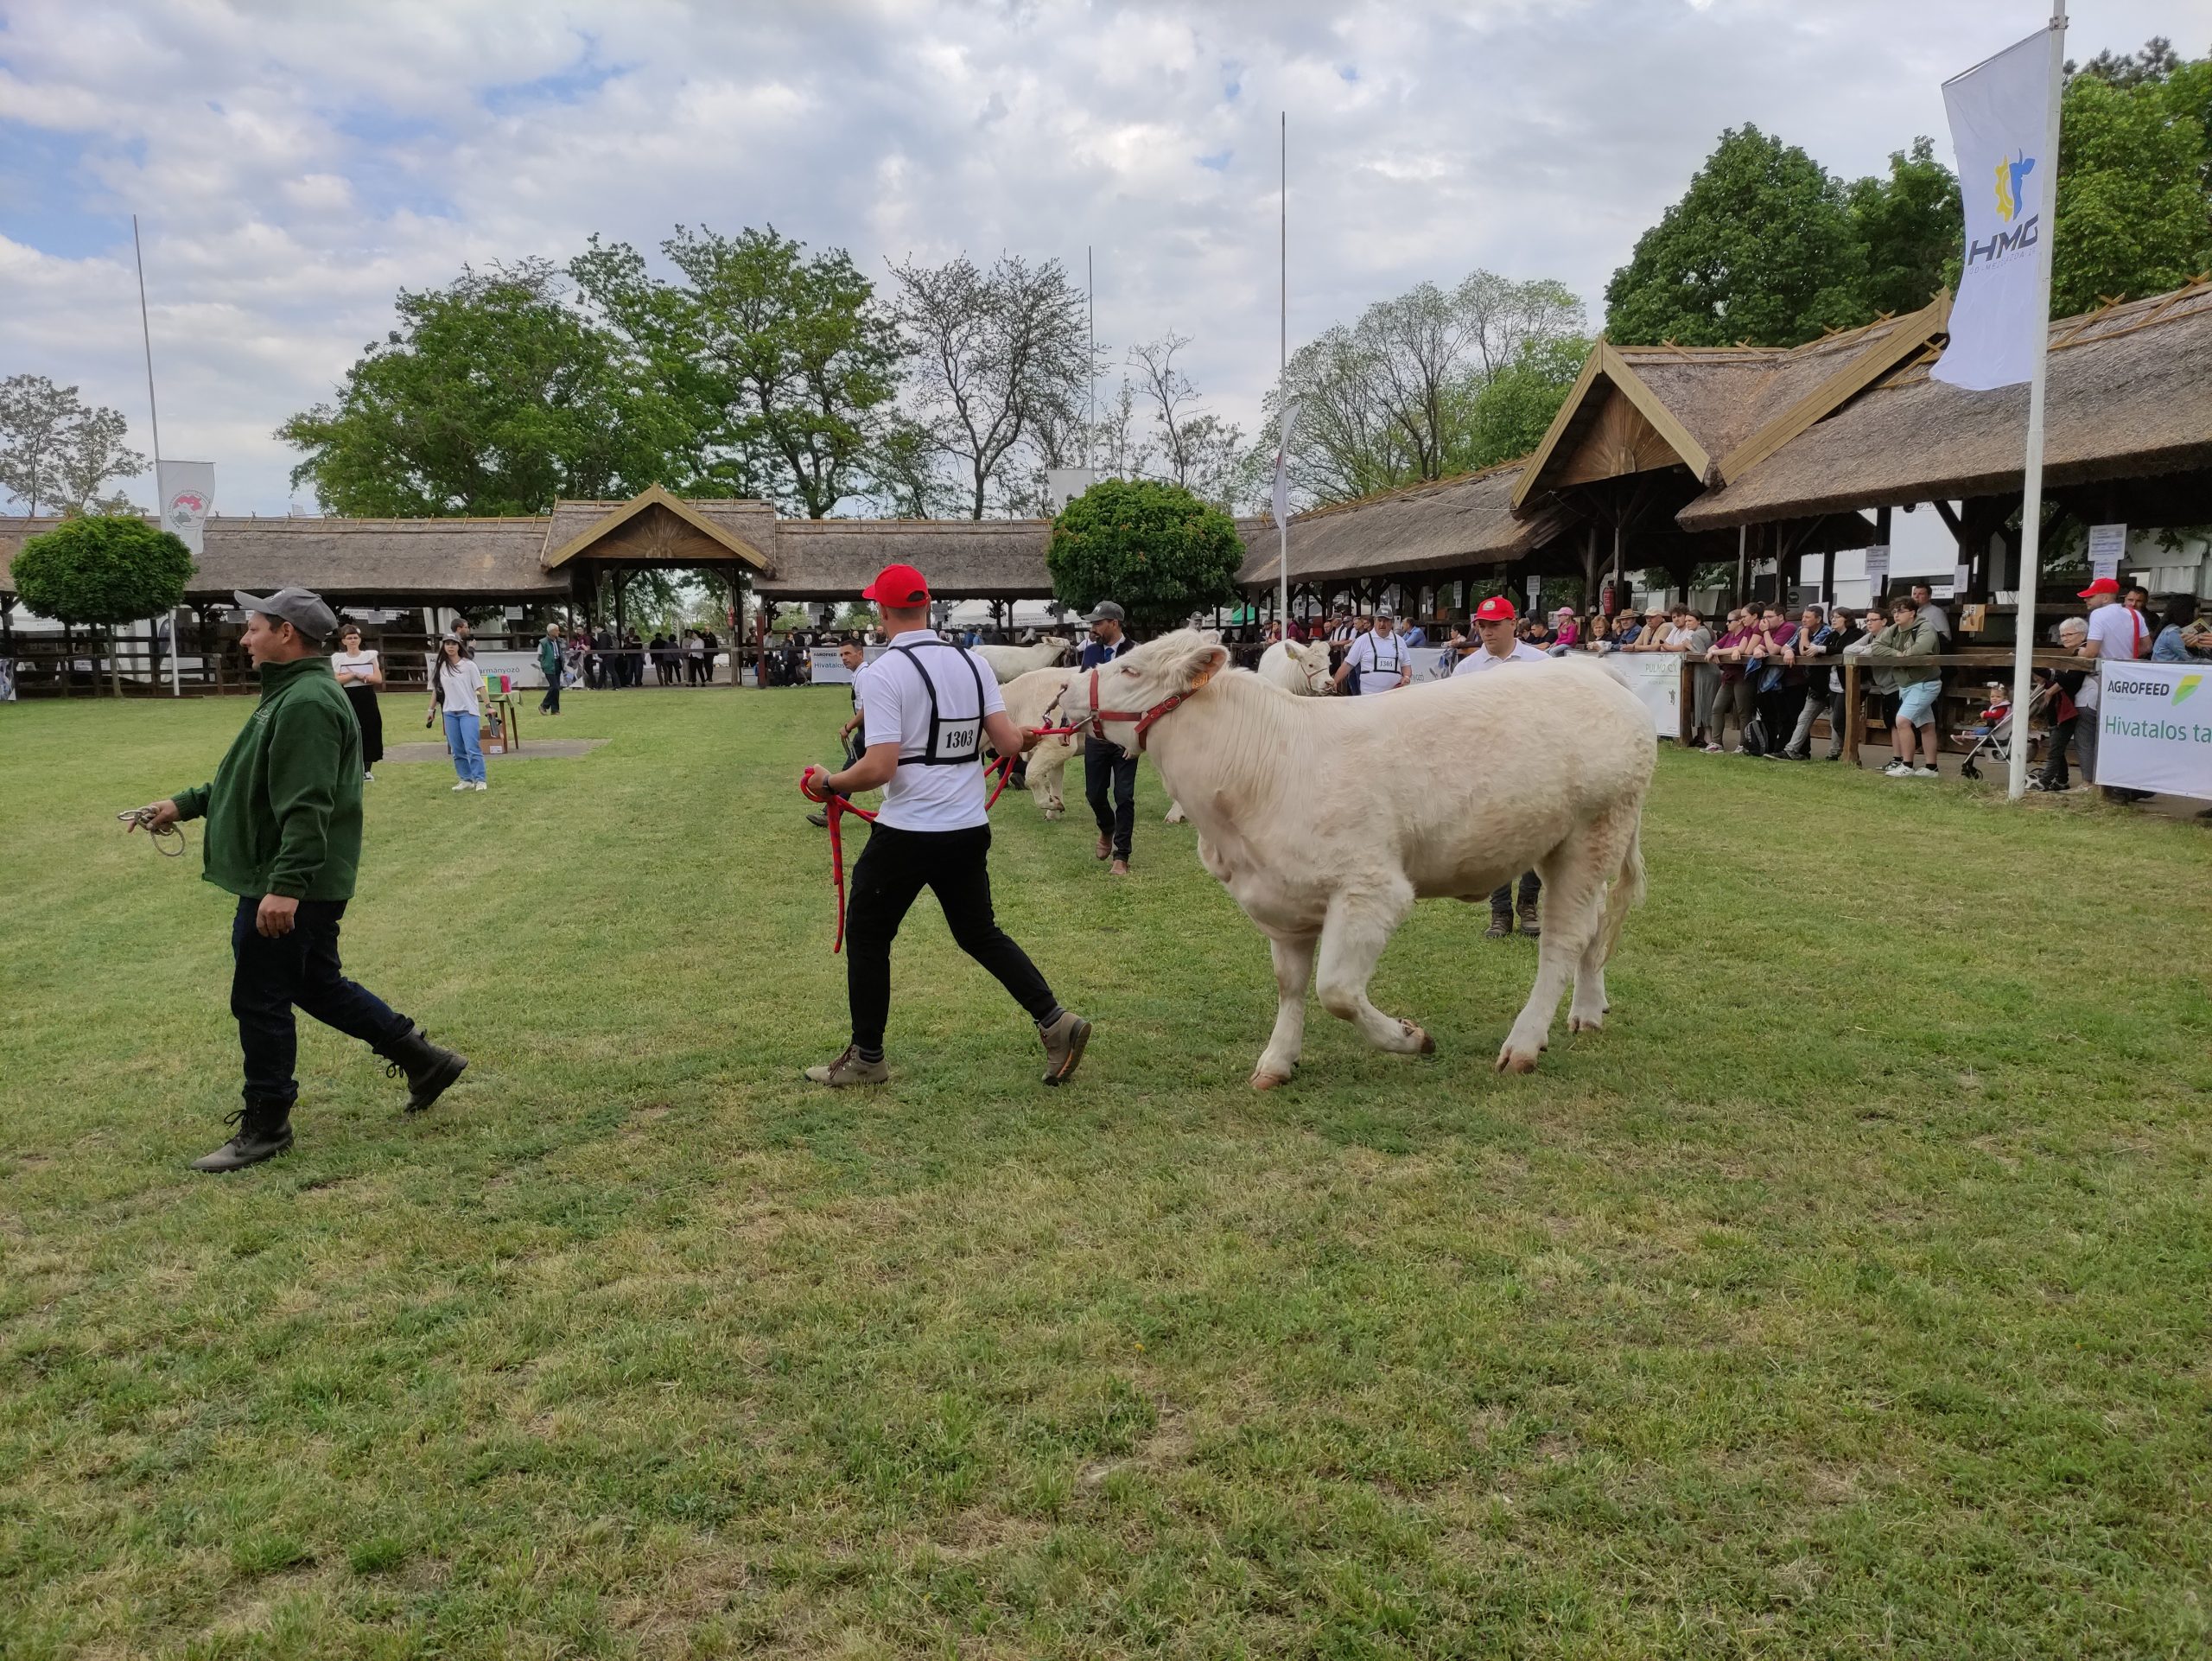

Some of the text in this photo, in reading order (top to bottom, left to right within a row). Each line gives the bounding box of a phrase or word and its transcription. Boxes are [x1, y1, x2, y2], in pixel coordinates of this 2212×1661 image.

[1967, 213, 2039, 266] HMG
[2107, 679, 2170, 697] AGROFEED
[945, 729, 974, 749] 1303
[2105, 715, 2188, 742] Hivatalos
